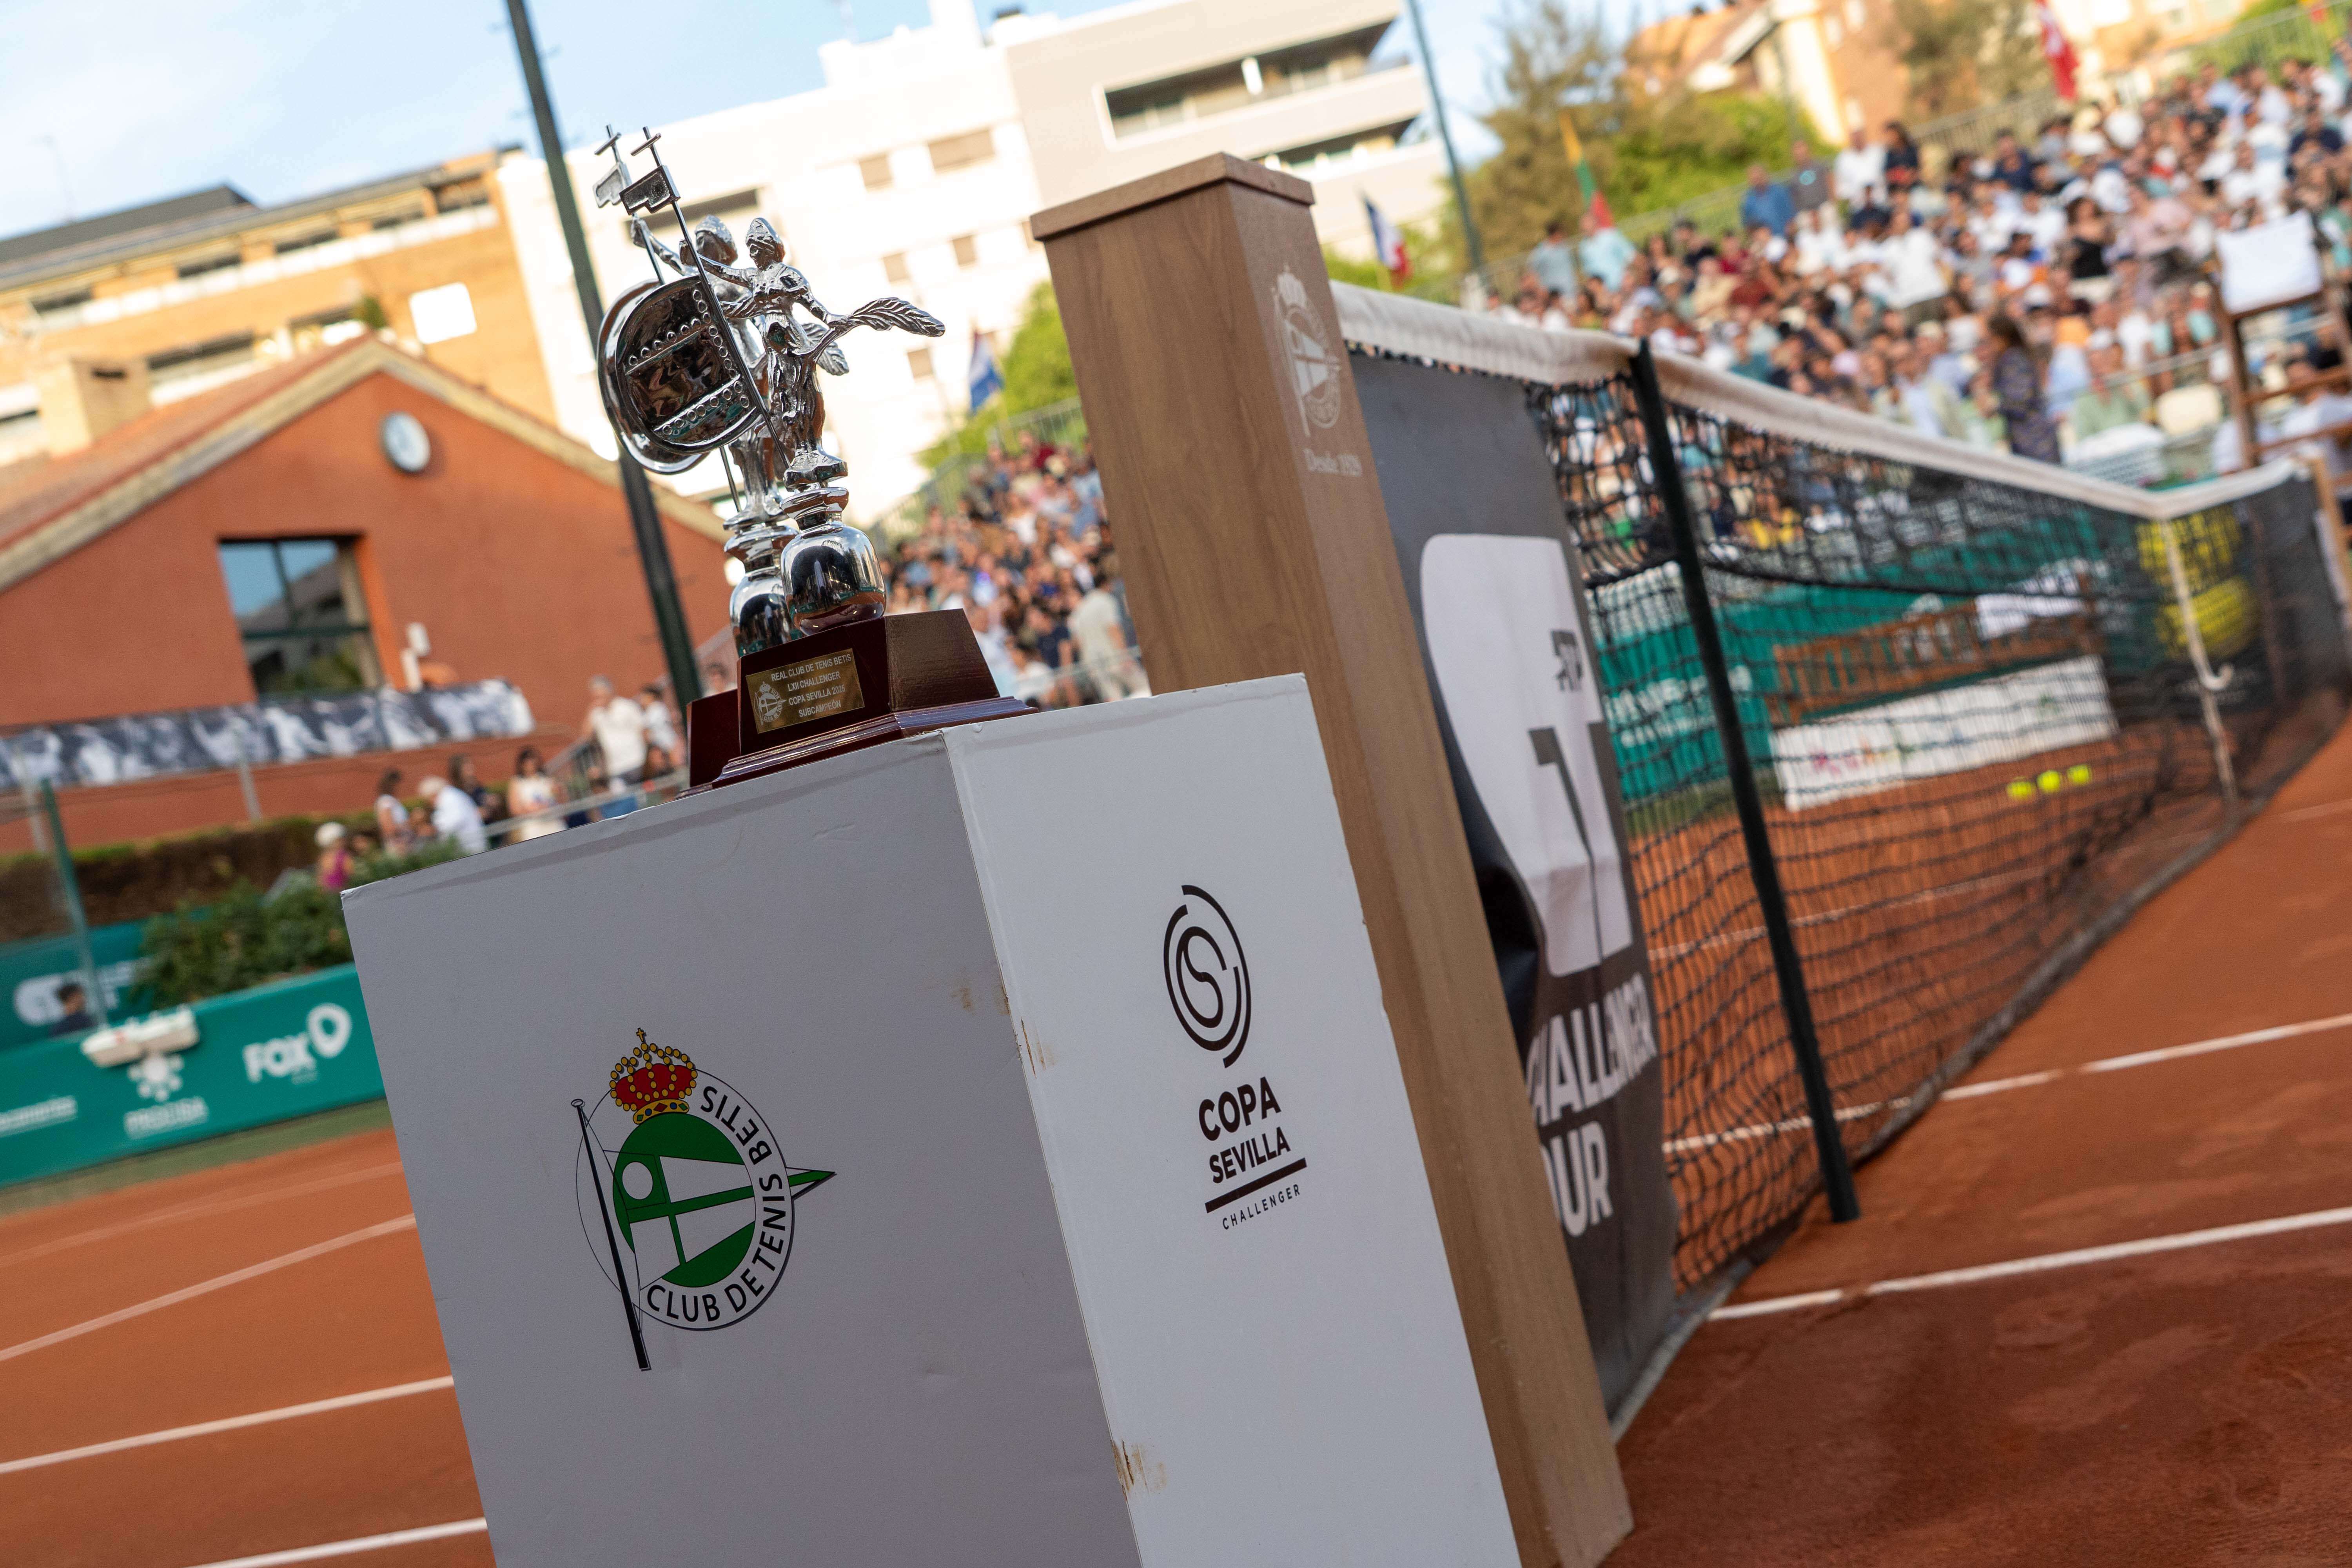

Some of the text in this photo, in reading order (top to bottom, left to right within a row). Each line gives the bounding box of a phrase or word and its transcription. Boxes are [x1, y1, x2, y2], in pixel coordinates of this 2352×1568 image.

[771, 653, 851, 681] REAL CLUB DE TENIS BETIS
[788, 671, 841, 691] LXII CHALLENGER
[789, 684, 846, 706] COPA SEVILLA 2025
[799, 700, 842, 717] SUBCAMPEÓN
[1199, 1076, 1281, 1142] COPA
[1209, 1126, 1291, 1184] SEVILLA
[646, 1085, 786, 1323] CLUB DE TENIS BETIS
[1222, 1183, 1301, 1230] CHALLENGER
